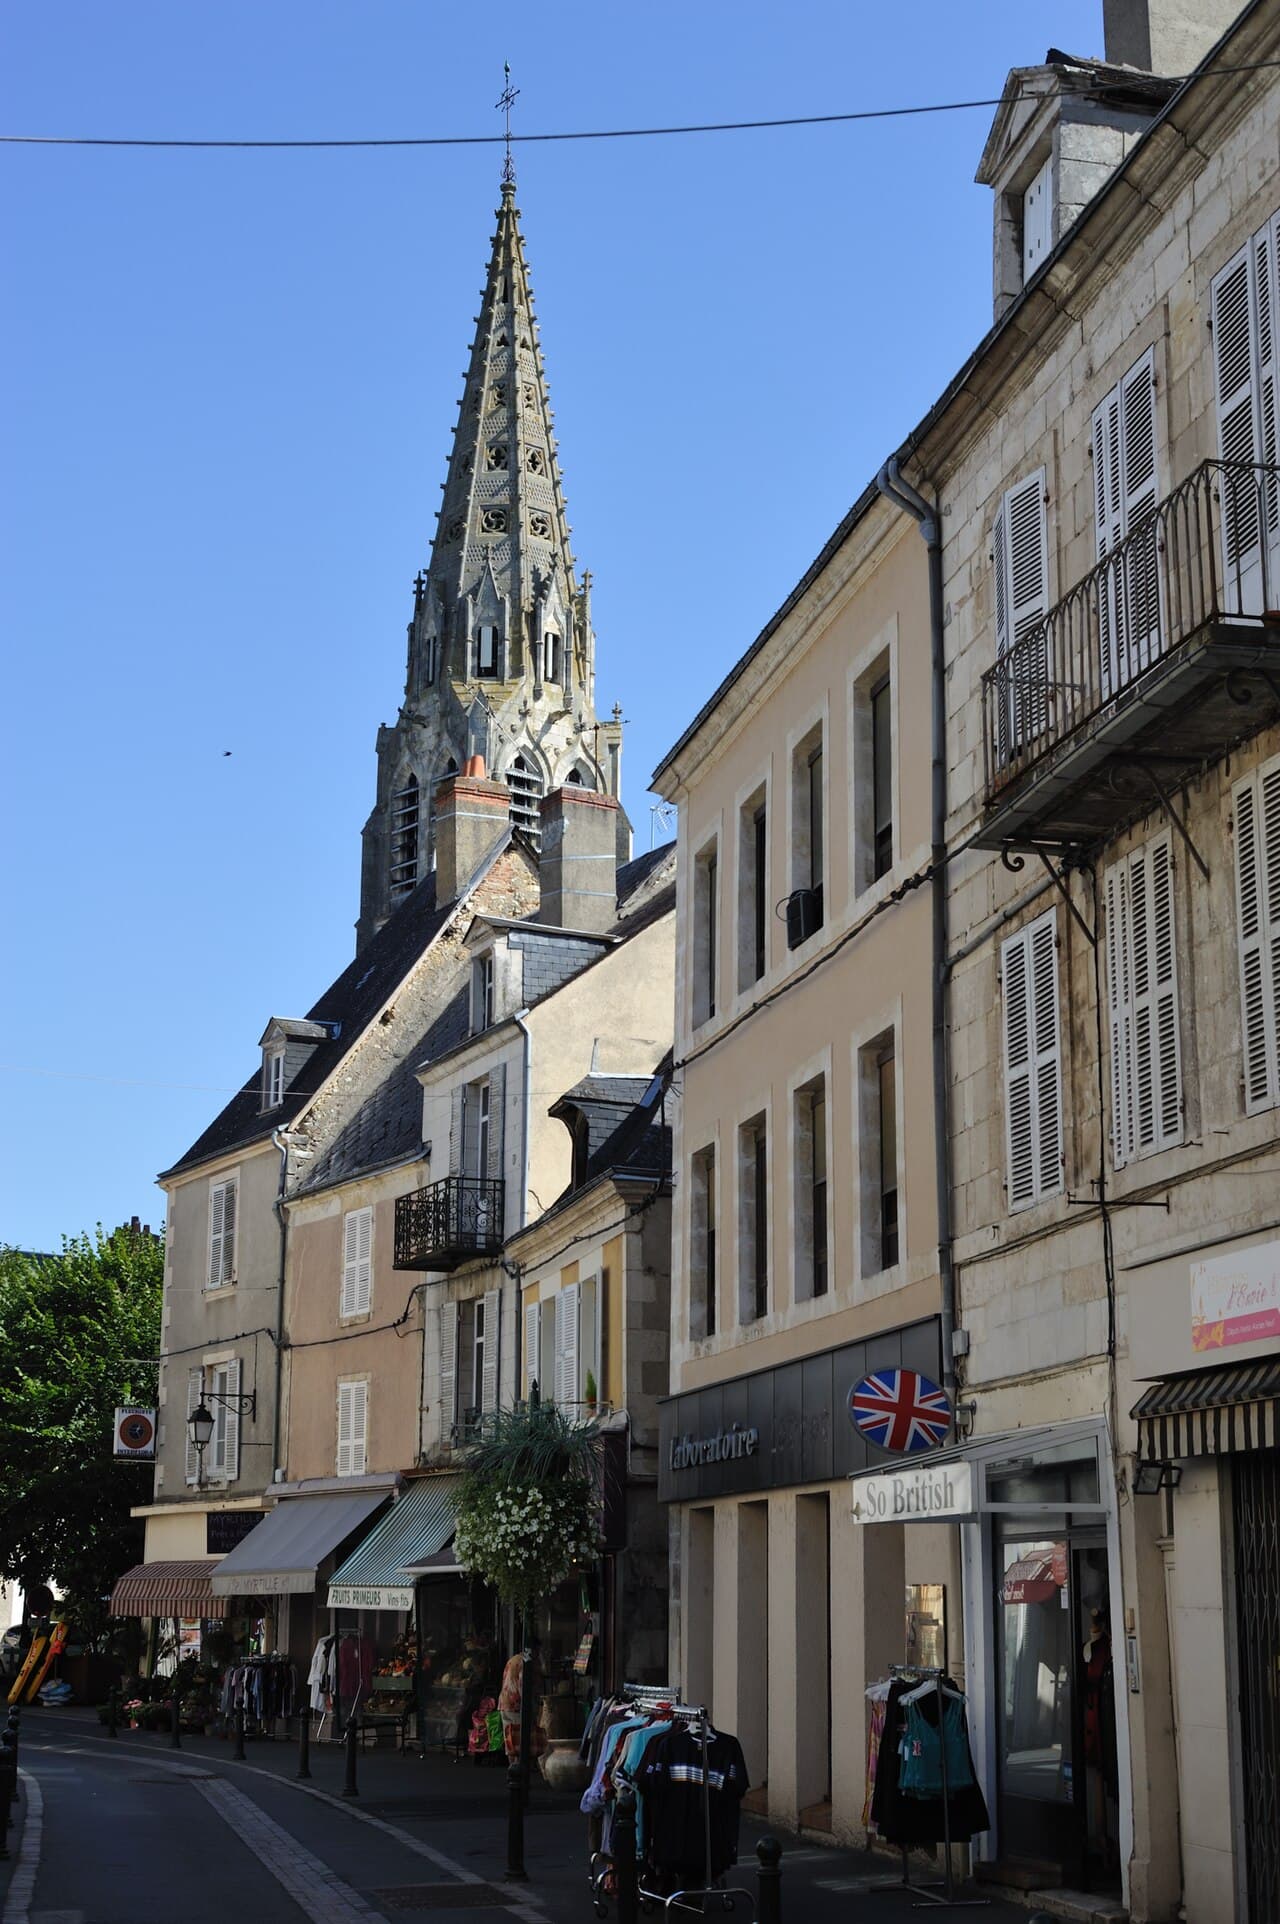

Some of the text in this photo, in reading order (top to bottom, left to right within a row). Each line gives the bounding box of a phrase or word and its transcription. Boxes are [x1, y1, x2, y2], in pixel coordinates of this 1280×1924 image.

[668, 1422, 759, 1471] laboratoire
[866, 1472, 955, 1517] So British
[332, 1590, 351, 1605] FRUITS
[352, 1590, 382, 1606] PRIMEURS
